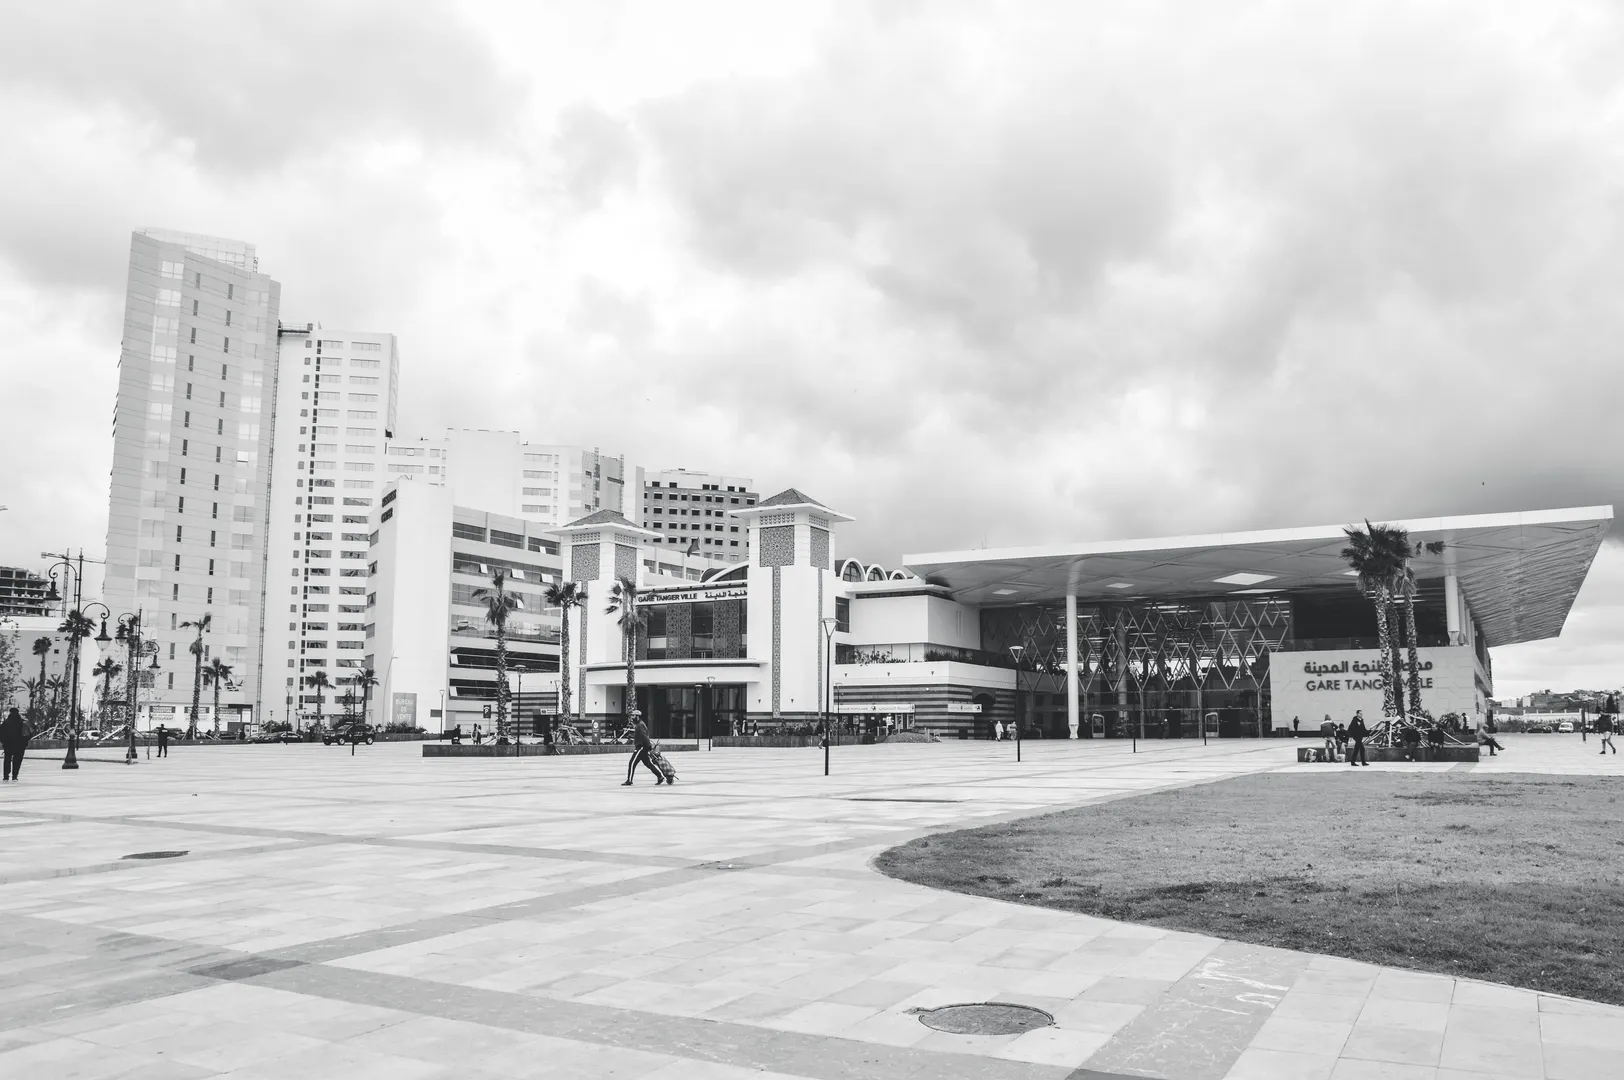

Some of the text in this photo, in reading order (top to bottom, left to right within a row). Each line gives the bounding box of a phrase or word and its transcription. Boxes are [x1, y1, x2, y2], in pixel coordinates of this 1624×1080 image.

[656, 594, 680, 602] TANGER
[1304, 660, 1349, 677] المدينة
[1306, 678, 1433, 691] GARE TANG VLE
